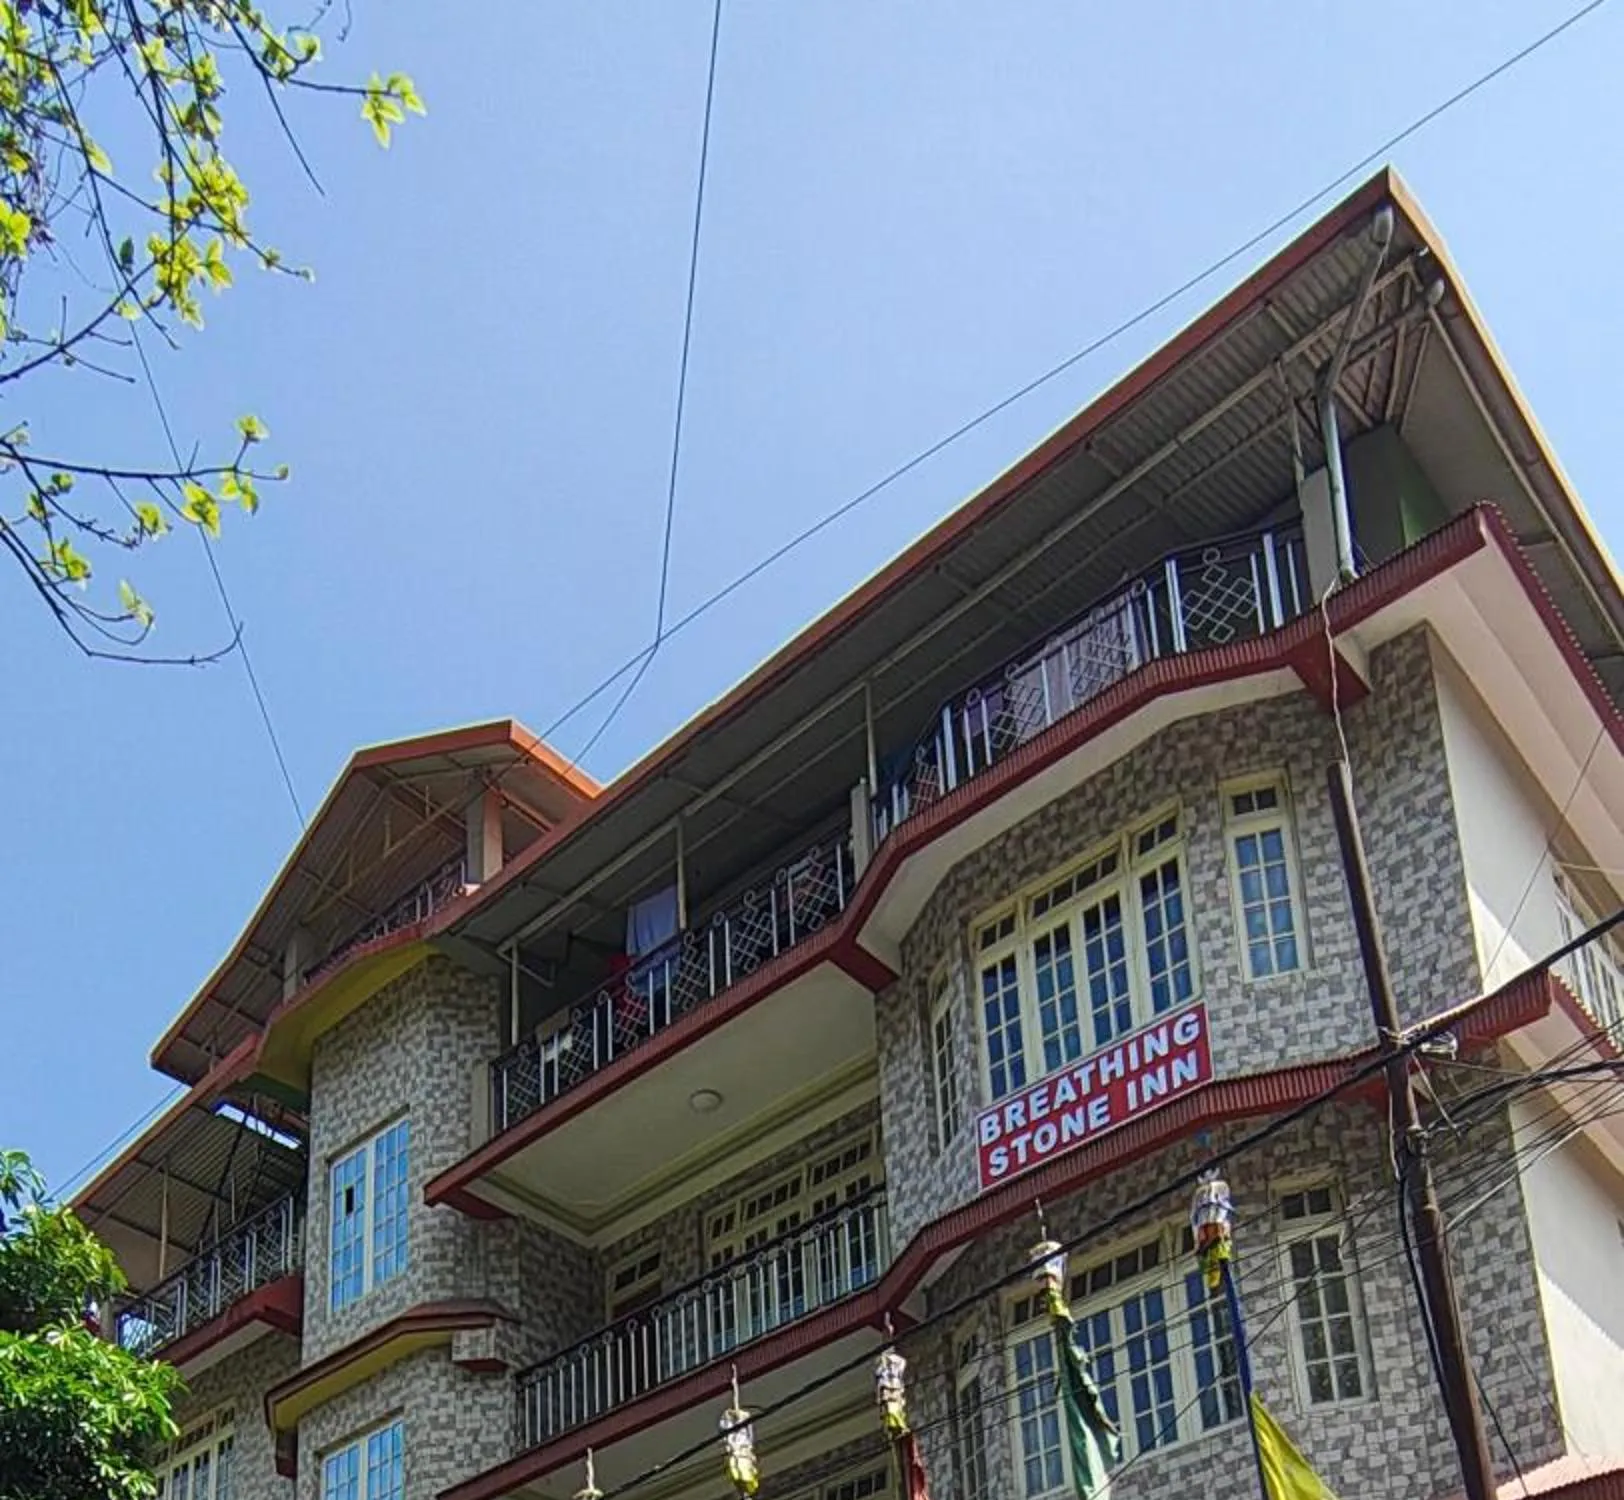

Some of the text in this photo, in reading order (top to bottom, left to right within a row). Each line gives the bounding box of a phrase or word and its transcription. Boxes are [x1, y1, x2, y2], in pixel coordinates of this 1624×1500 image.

[980, 1013, 1200, 1146] BREATHING
[989, 1050, 1198, 1177] STONE INN
